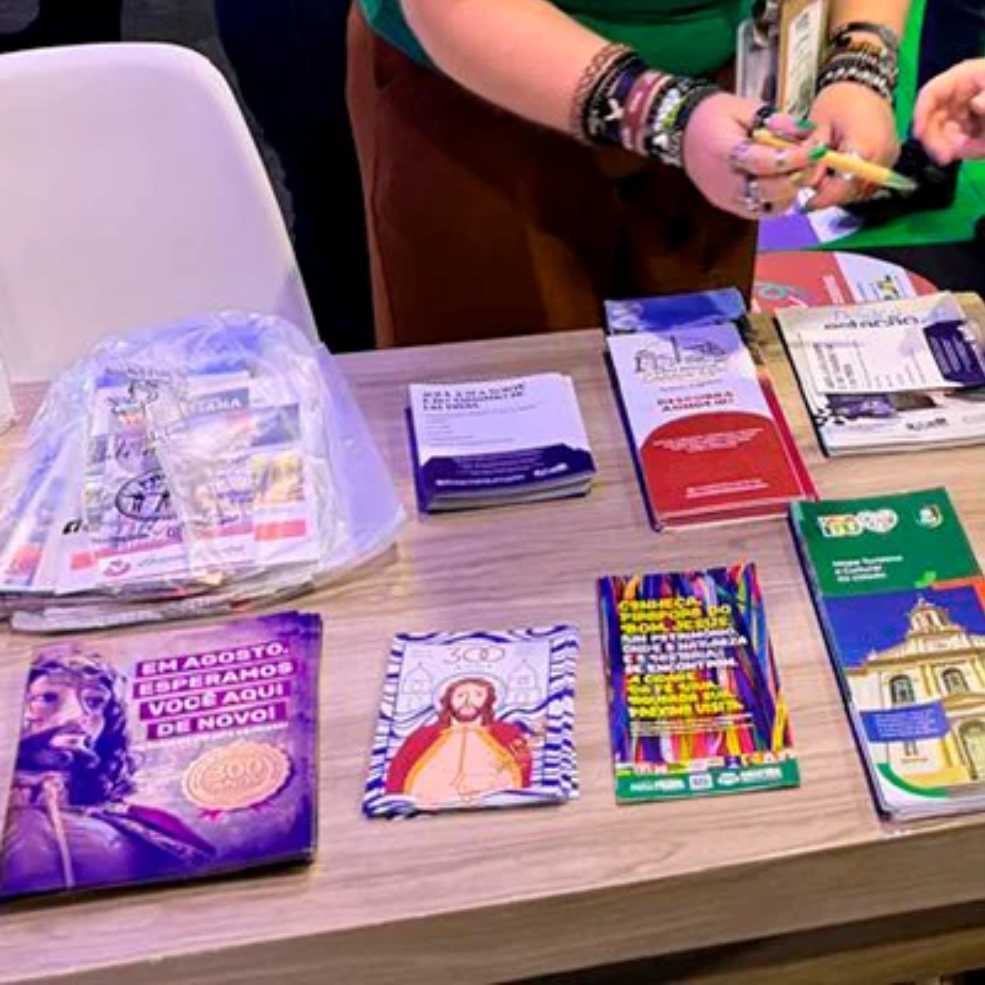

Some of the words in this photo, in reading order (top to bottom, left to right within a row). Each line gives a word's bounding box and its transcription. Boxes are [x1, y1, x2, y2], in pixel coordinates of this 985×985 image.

[139, 662, 294, 696] ESPERAMOS
[141, 660, 178, 675] EM
[149, 691, 217, 716] VOCÊ
[223, 683, 284, 706] AQUI
[156, 720, 191, 736] DE
[197, 706, 276, 731] NOVO!
